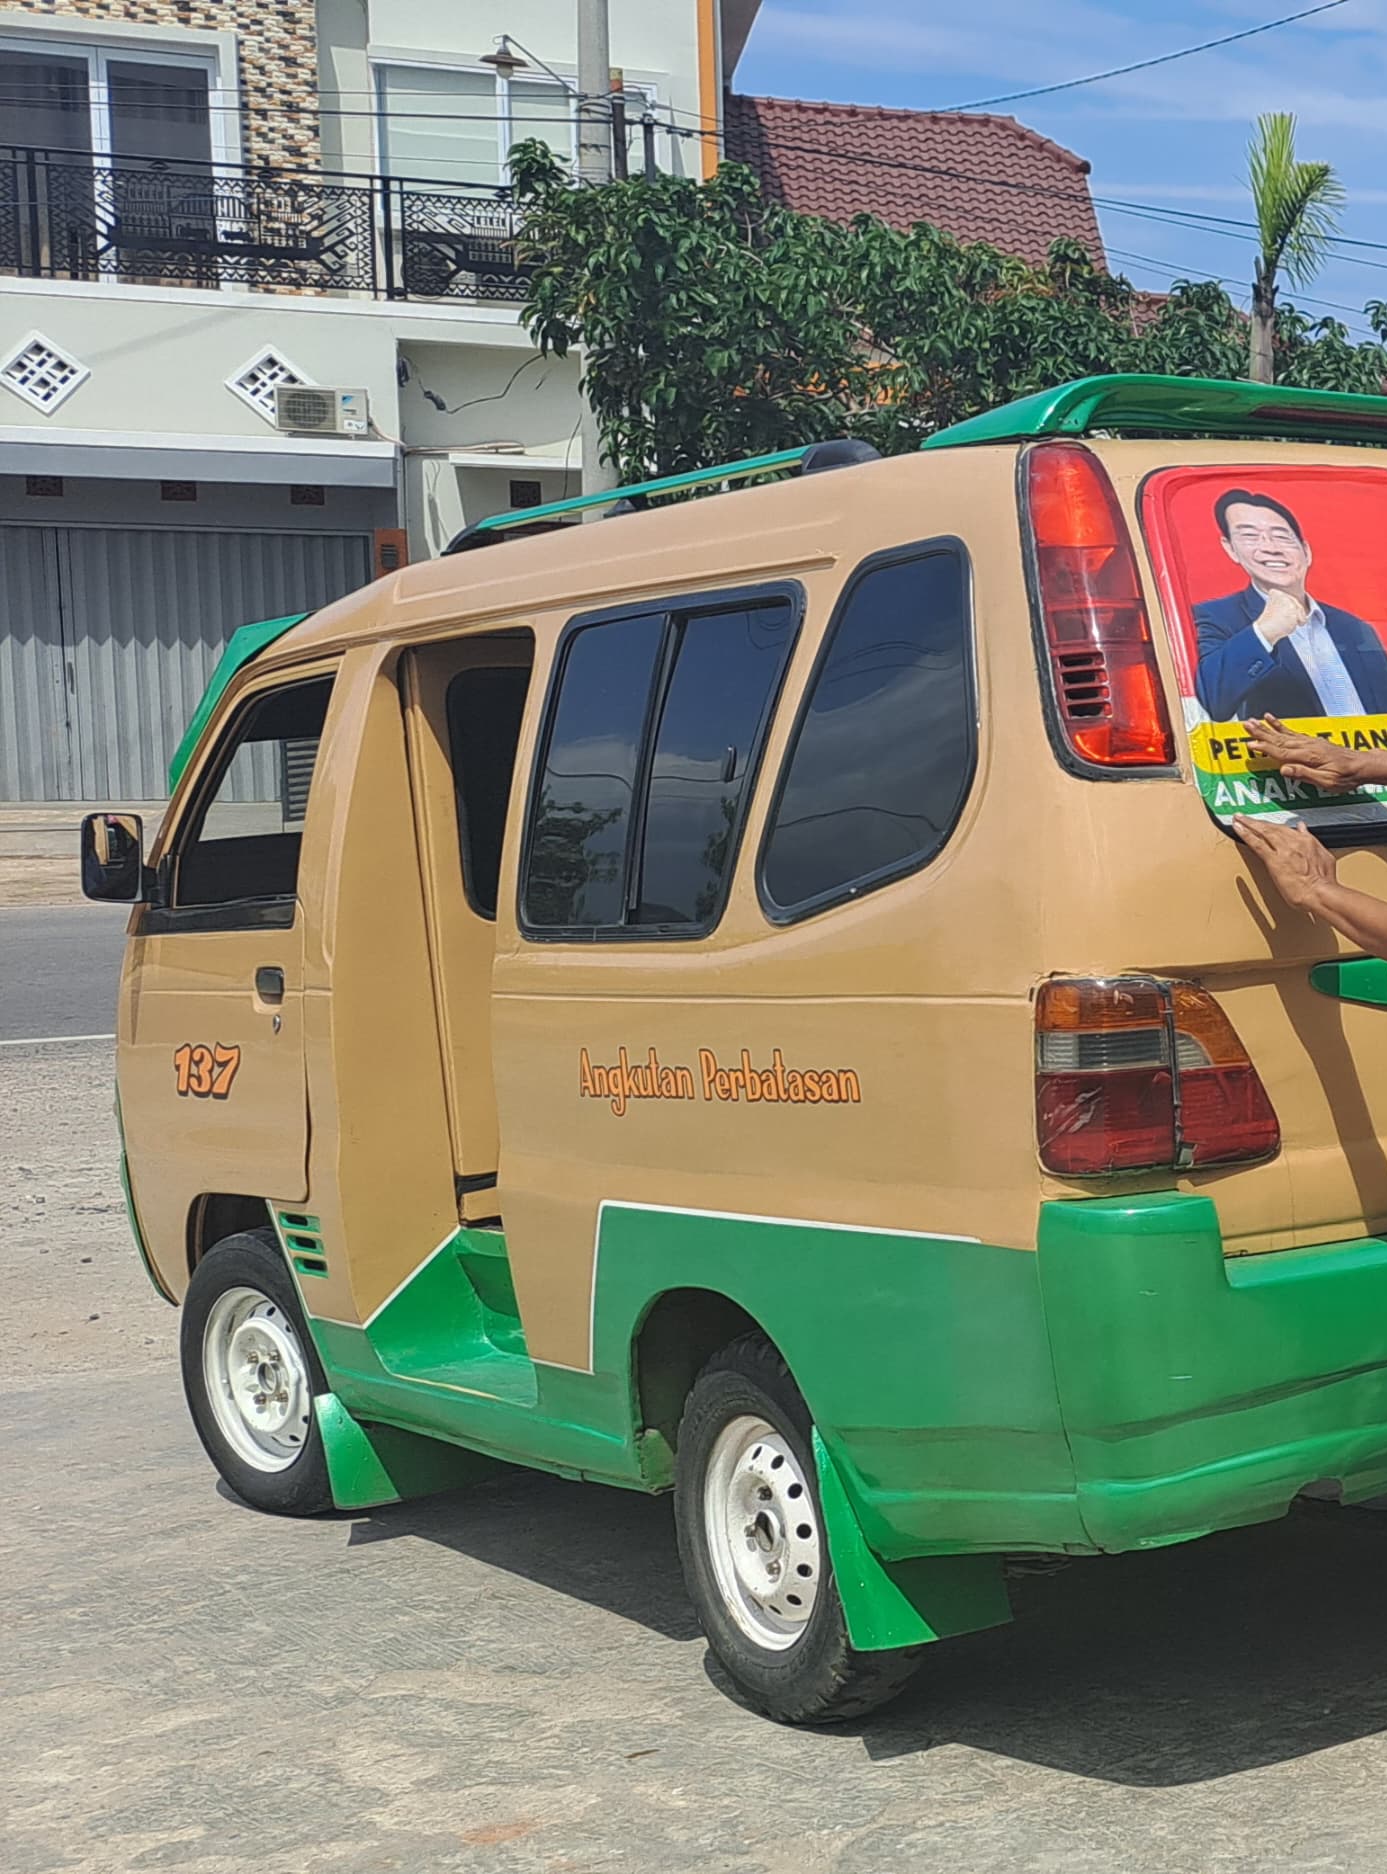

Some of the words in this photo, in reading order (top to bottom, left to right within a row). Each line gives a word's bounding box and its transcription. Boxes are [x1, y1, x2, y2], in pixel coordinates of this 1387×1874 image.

[1213, 776, 1308, 808] ANAK
[174, 1041, 241, 1100] 137
[579, 1047, 695, 1117] Angkutan
[699, 1048, 861, 1103] Perbatasan
